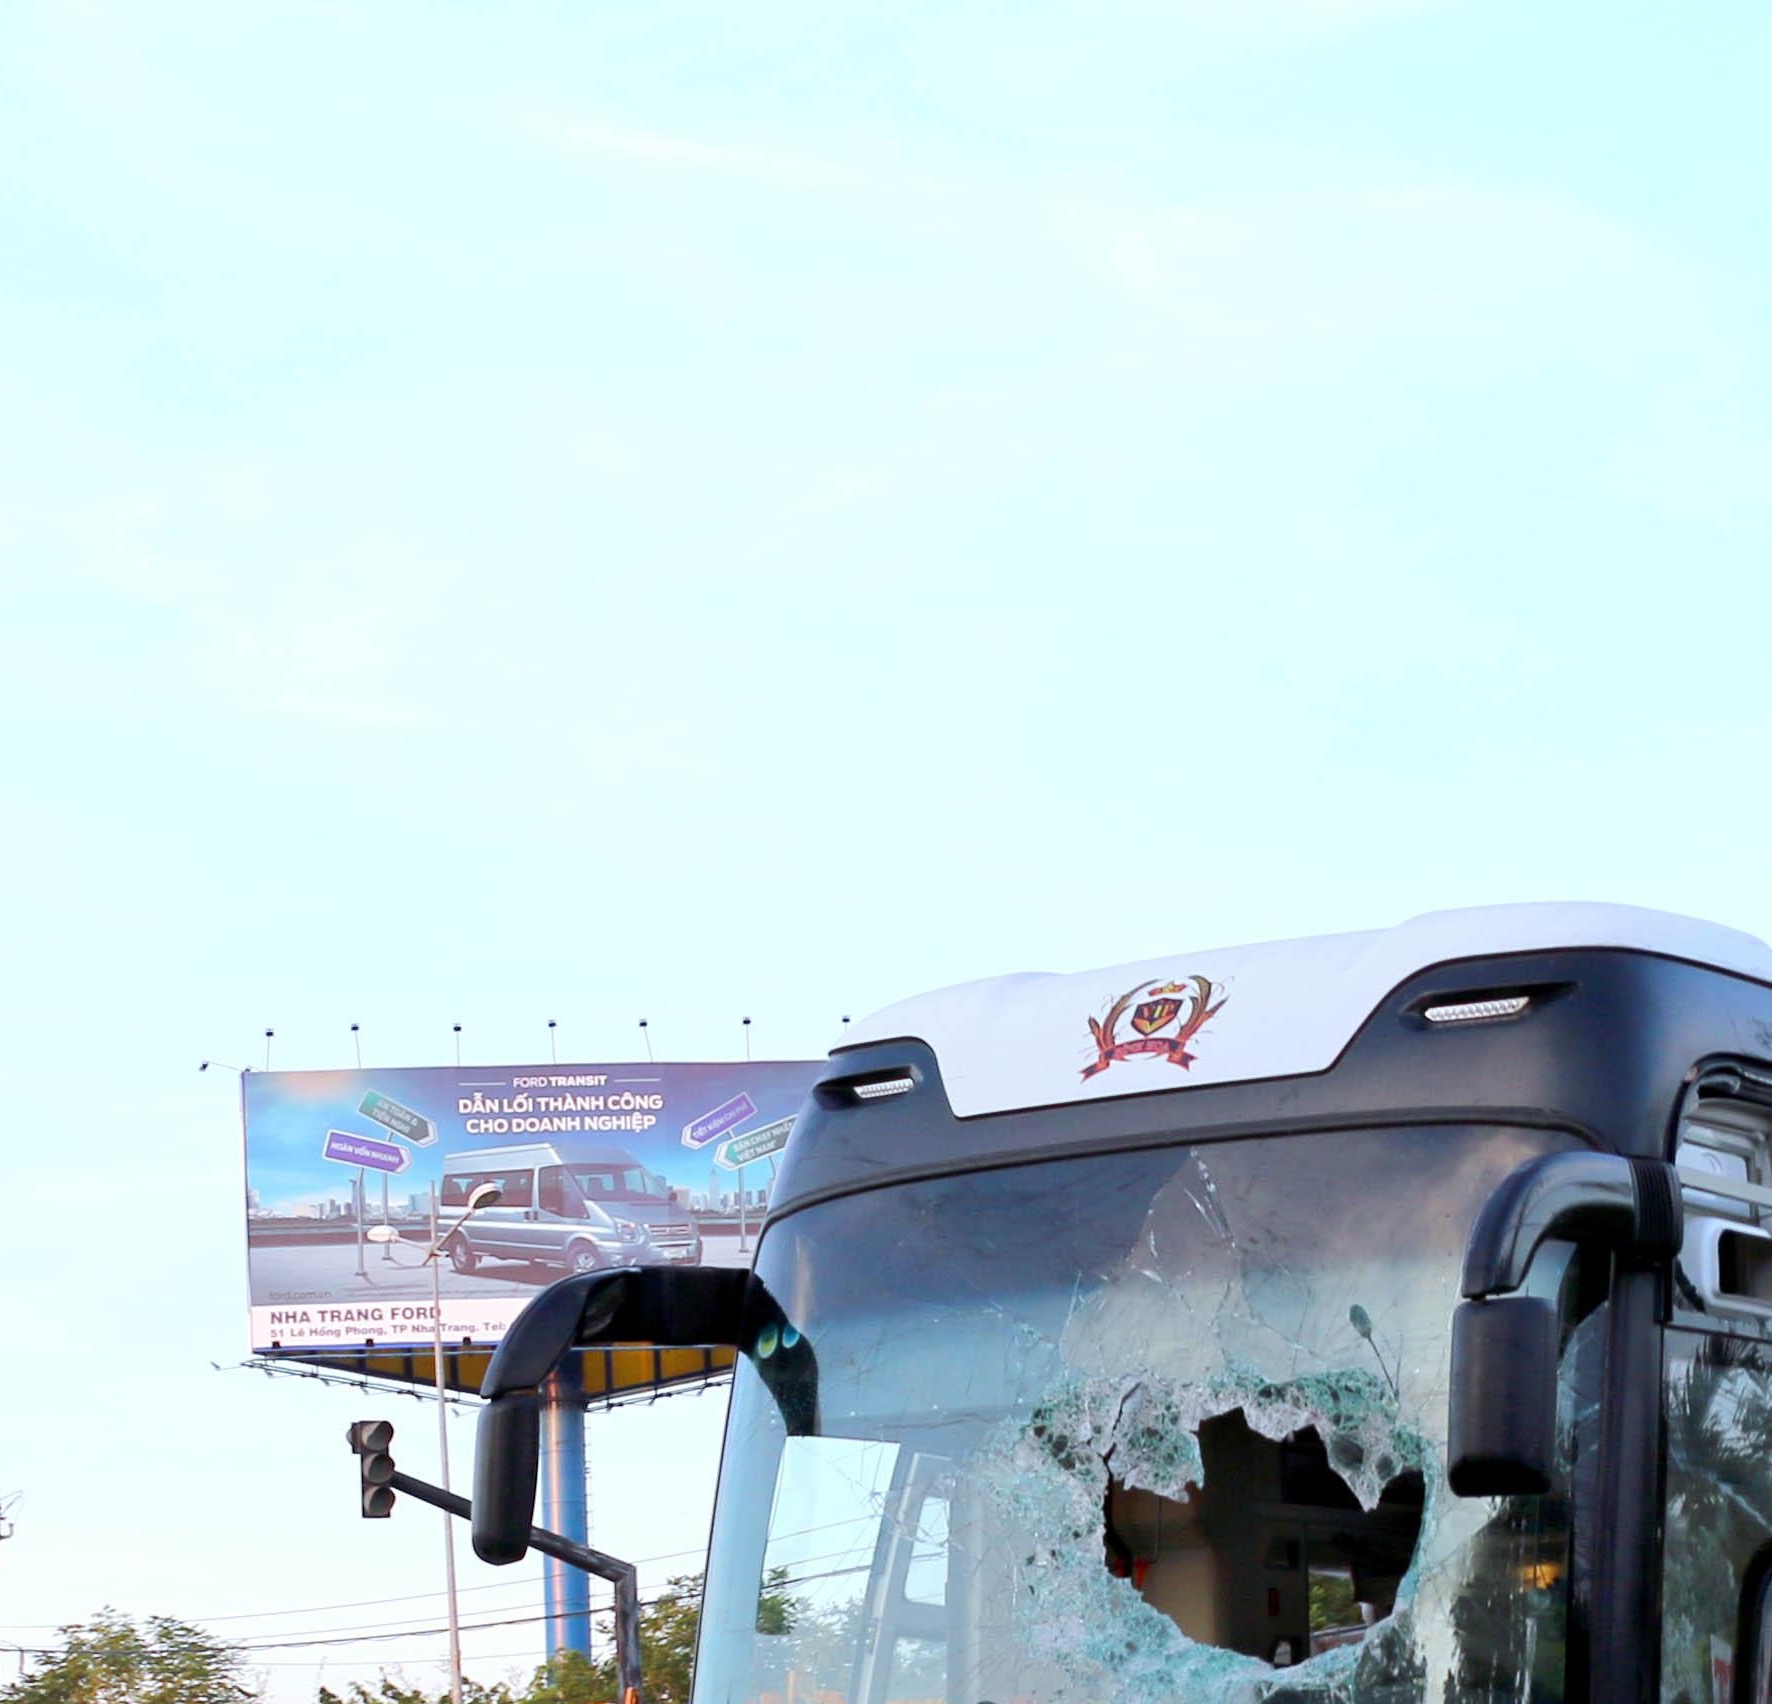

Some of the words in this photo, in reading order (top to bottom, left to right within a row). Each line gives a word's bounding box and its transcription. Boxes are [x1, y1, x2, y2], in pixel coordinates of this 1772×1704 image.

[513, 1077, 548, 1088] FORD
[548, 1075, 608, 1087] TRANSIT
[458, 1092, 499, 1114] DẪN
[502, 1092, 533, 1113] LỐI
[536, 1093, 605, 1112] THÀNH
[607, 1092, 664, 1111] CÔNG
[466, 1118, 509, 1133] CHO
[512, 1116, 580, 1133] DOANH
[584, 1112, 657, 1133] NGHIỆP
[270, 1310, 311, 1324] NHA
[317, 1308, 384, 1322] TRANG
[390, 1306, 441, 1320] FORD
[270, 1329, 284, 1338] 51
[392, 1324, 409, 1334] TP
[411, 1323, 436, 1334] Nha
[483, 1321, 506, 1331] Tel:
